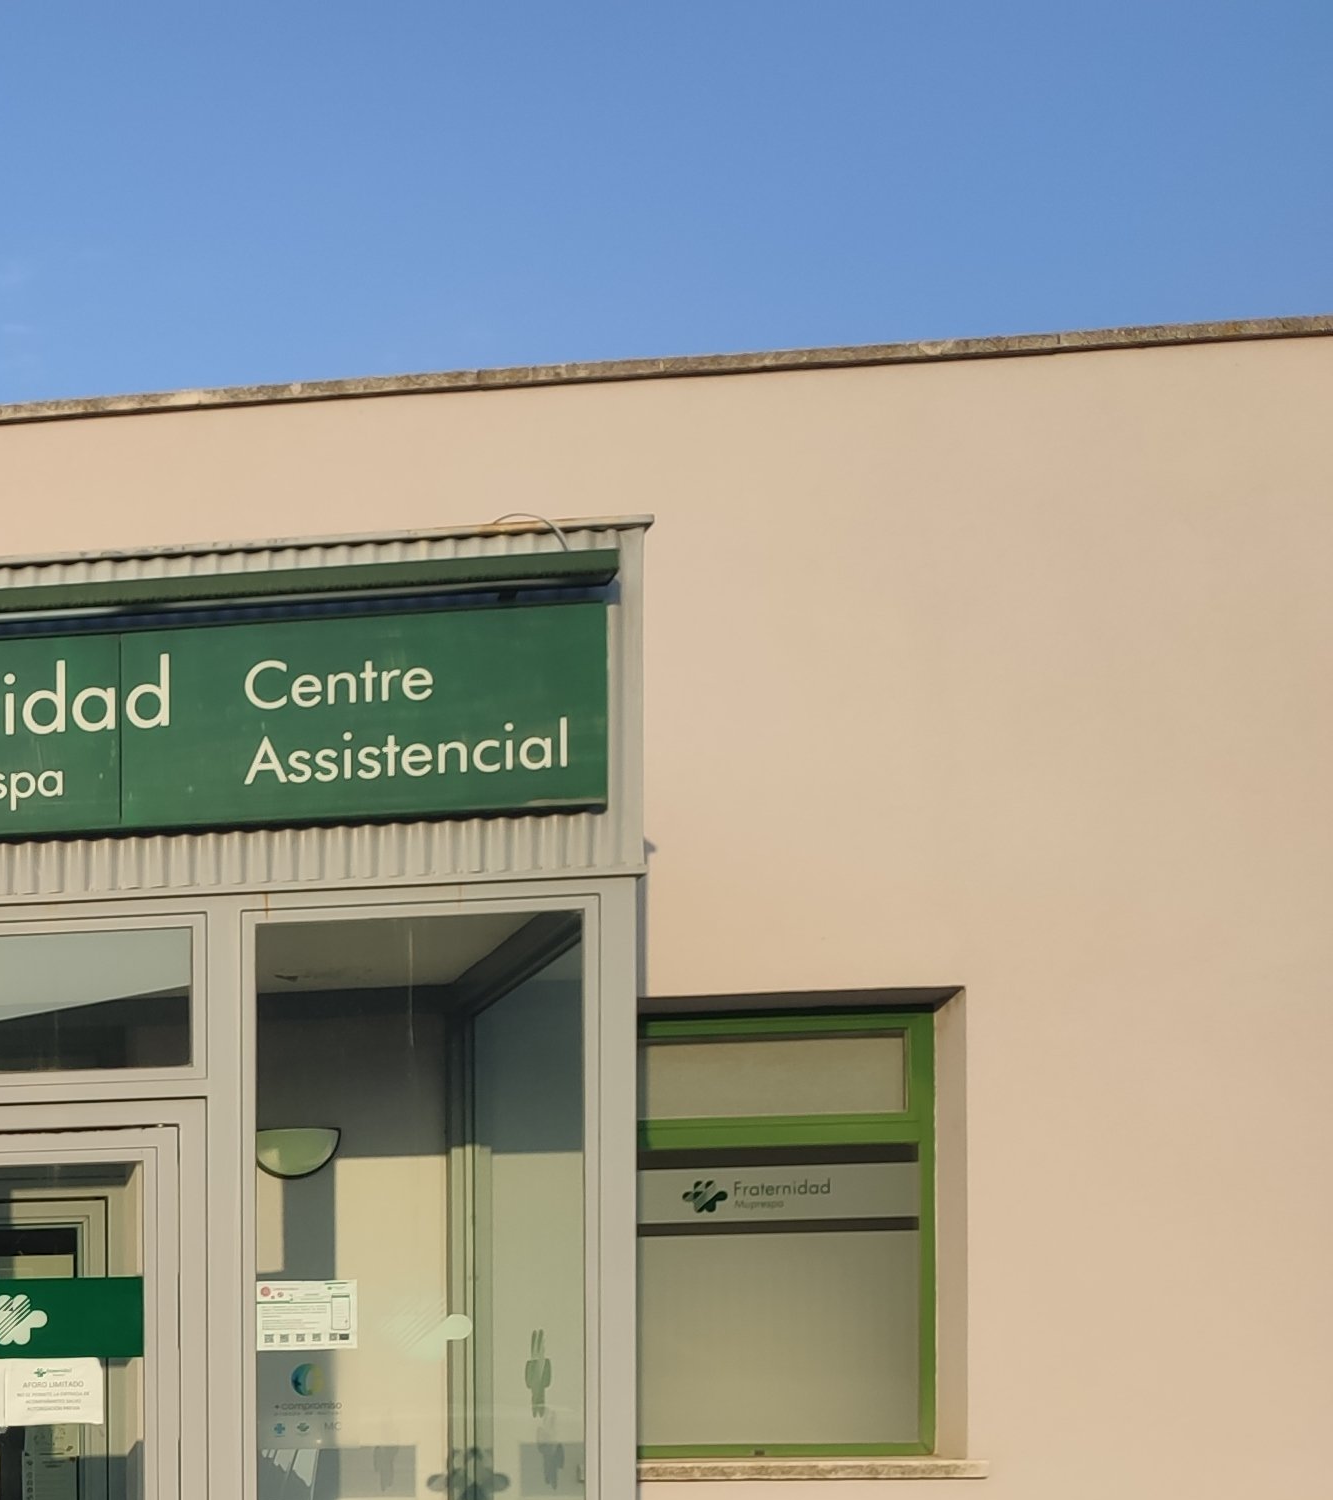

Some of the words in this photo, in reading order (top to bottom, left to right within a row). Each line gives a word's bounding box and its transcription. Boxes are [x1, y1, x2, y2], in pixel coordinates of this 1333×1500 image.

[244, 660, 434, 711] Centre
[244, 717, 570, 786] Assistencial
[733, 1178, 831, 1196] Fraternidad
[733, 1199, 784, 1210] Muprespa
